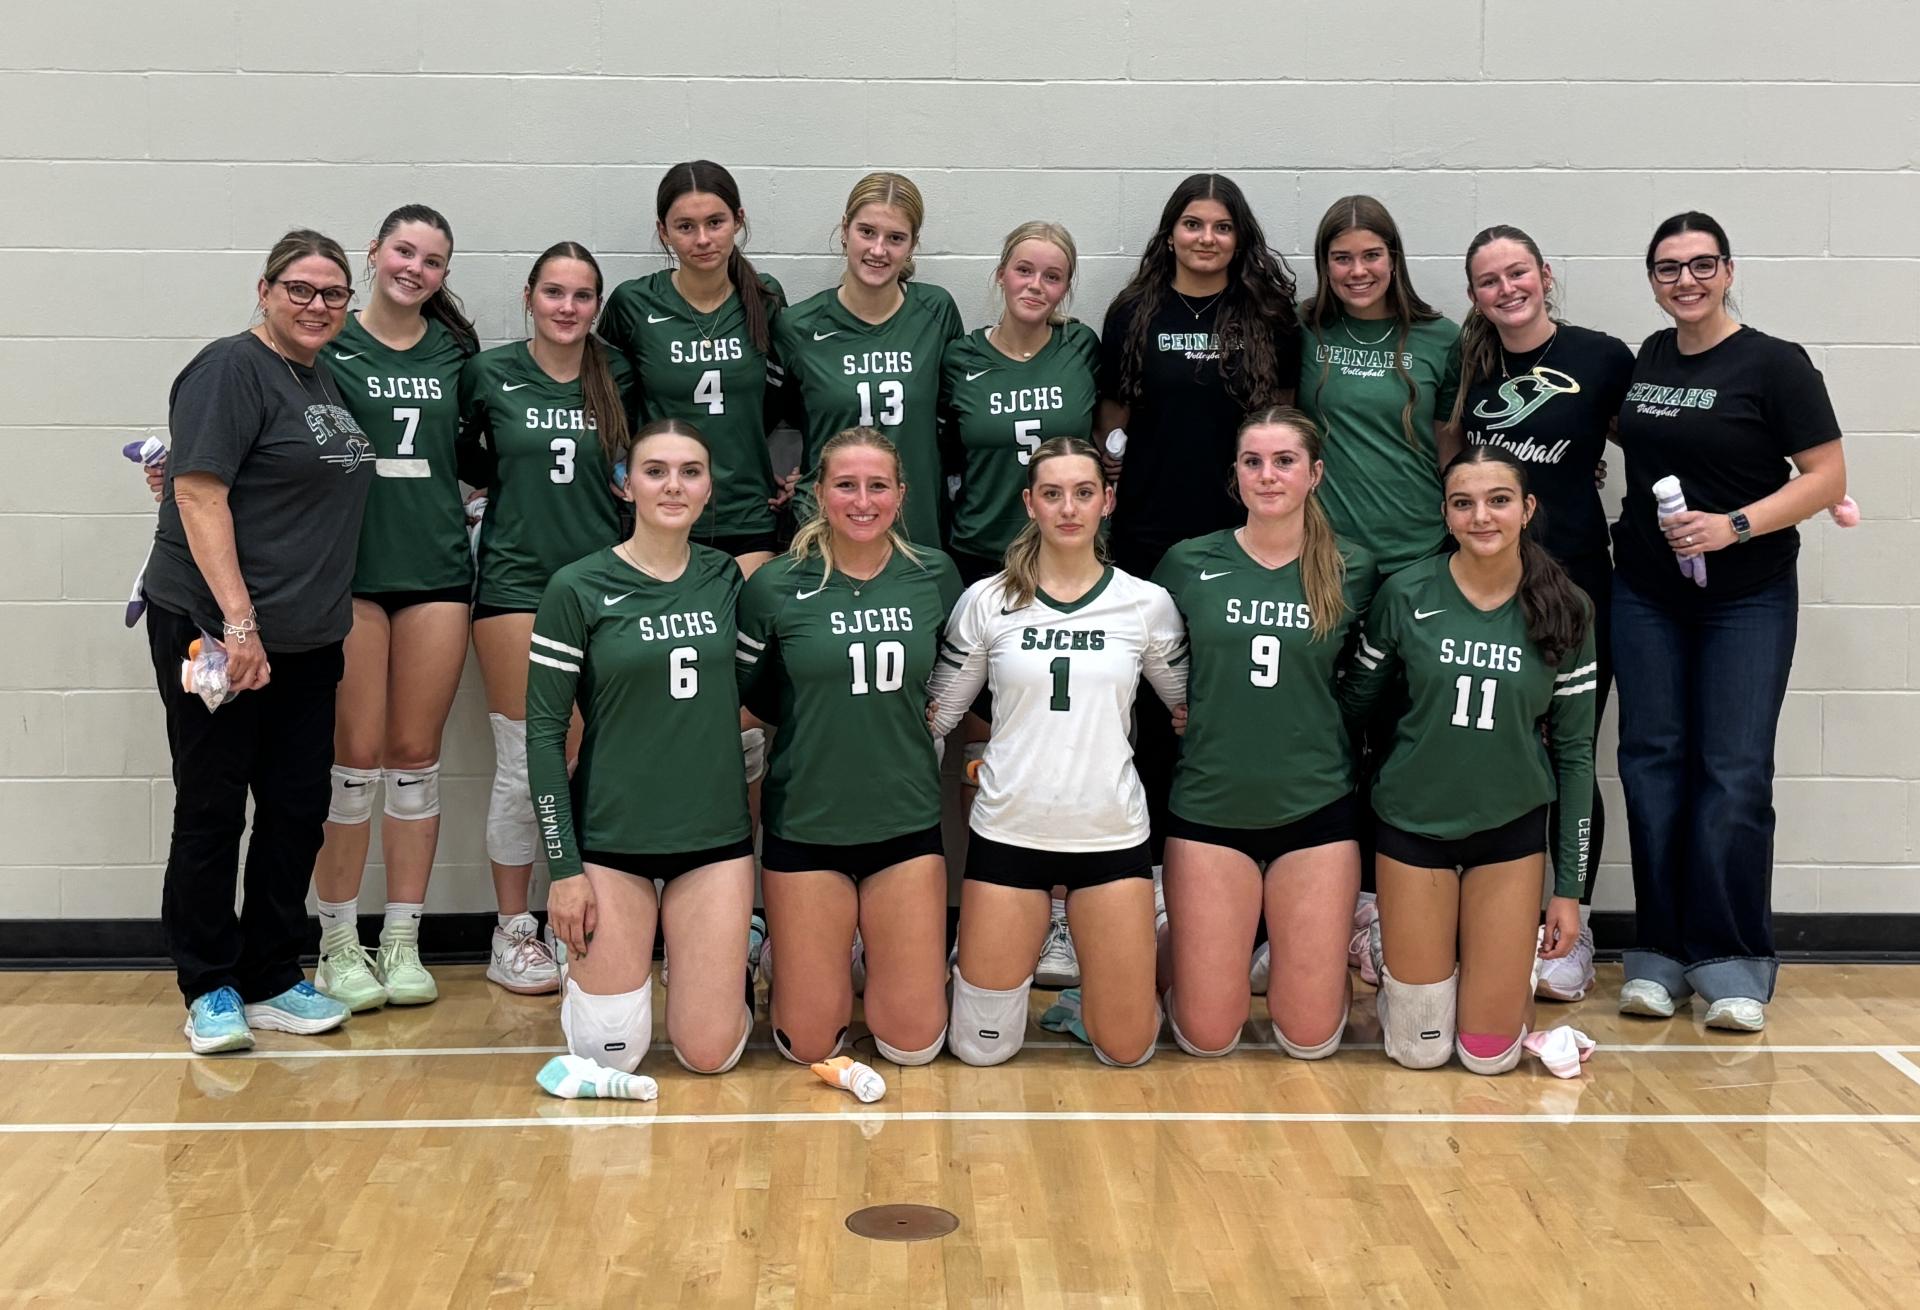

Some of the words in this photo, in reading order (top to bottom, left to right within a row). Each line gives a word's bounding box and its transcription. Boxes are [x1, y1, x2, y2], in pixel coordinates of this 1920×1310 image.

[671, 337, 743, 363] SJCHS
[1158, 333, 1246, 352] CEINA
[1184, 351, 1227, 361] Volleyba
[1316, 344, 1413, 370] CEINAHS
[843, 351, 913, 375] SJCHS
[1340, 366, 1386, 378] Volleyball
[366, 376, 443, 400] SJCHS
[693, 369, 725, 415] 4
[856, 380, 904, 427] 13
[990, 386, 1063, 414] SJCHS
[1625, 382, 1718, 410] CEINAHS
[525, 407, 599, 431] SJCHS
[1636, 403, 1681, 418] Volleyball
[392, 407, 421, 455] 7
[1014, 419, 1042, 466] 5
[549, 437, 576, 484] 3
[639, 610, 718, 641] SJCHS
[830, 607, 914, 635] SJCHS
[1226, 598, 1311, 630] SJCHS
[1020, 627, 1106, 651] SJCHS
[848, 641, 905, 695] 10
[1249, 634, 1281, 689] 9
[1439, 638, 1523, 673] SJCHS
[669, 646, 699, 700] 6
[1049, 656, 1071, 712] 1
[1451, 674, 1498, 730] 11
[538, 794, 564, 859] CEINAHS
[1577, 817, 1592, 882] CEINAHS
